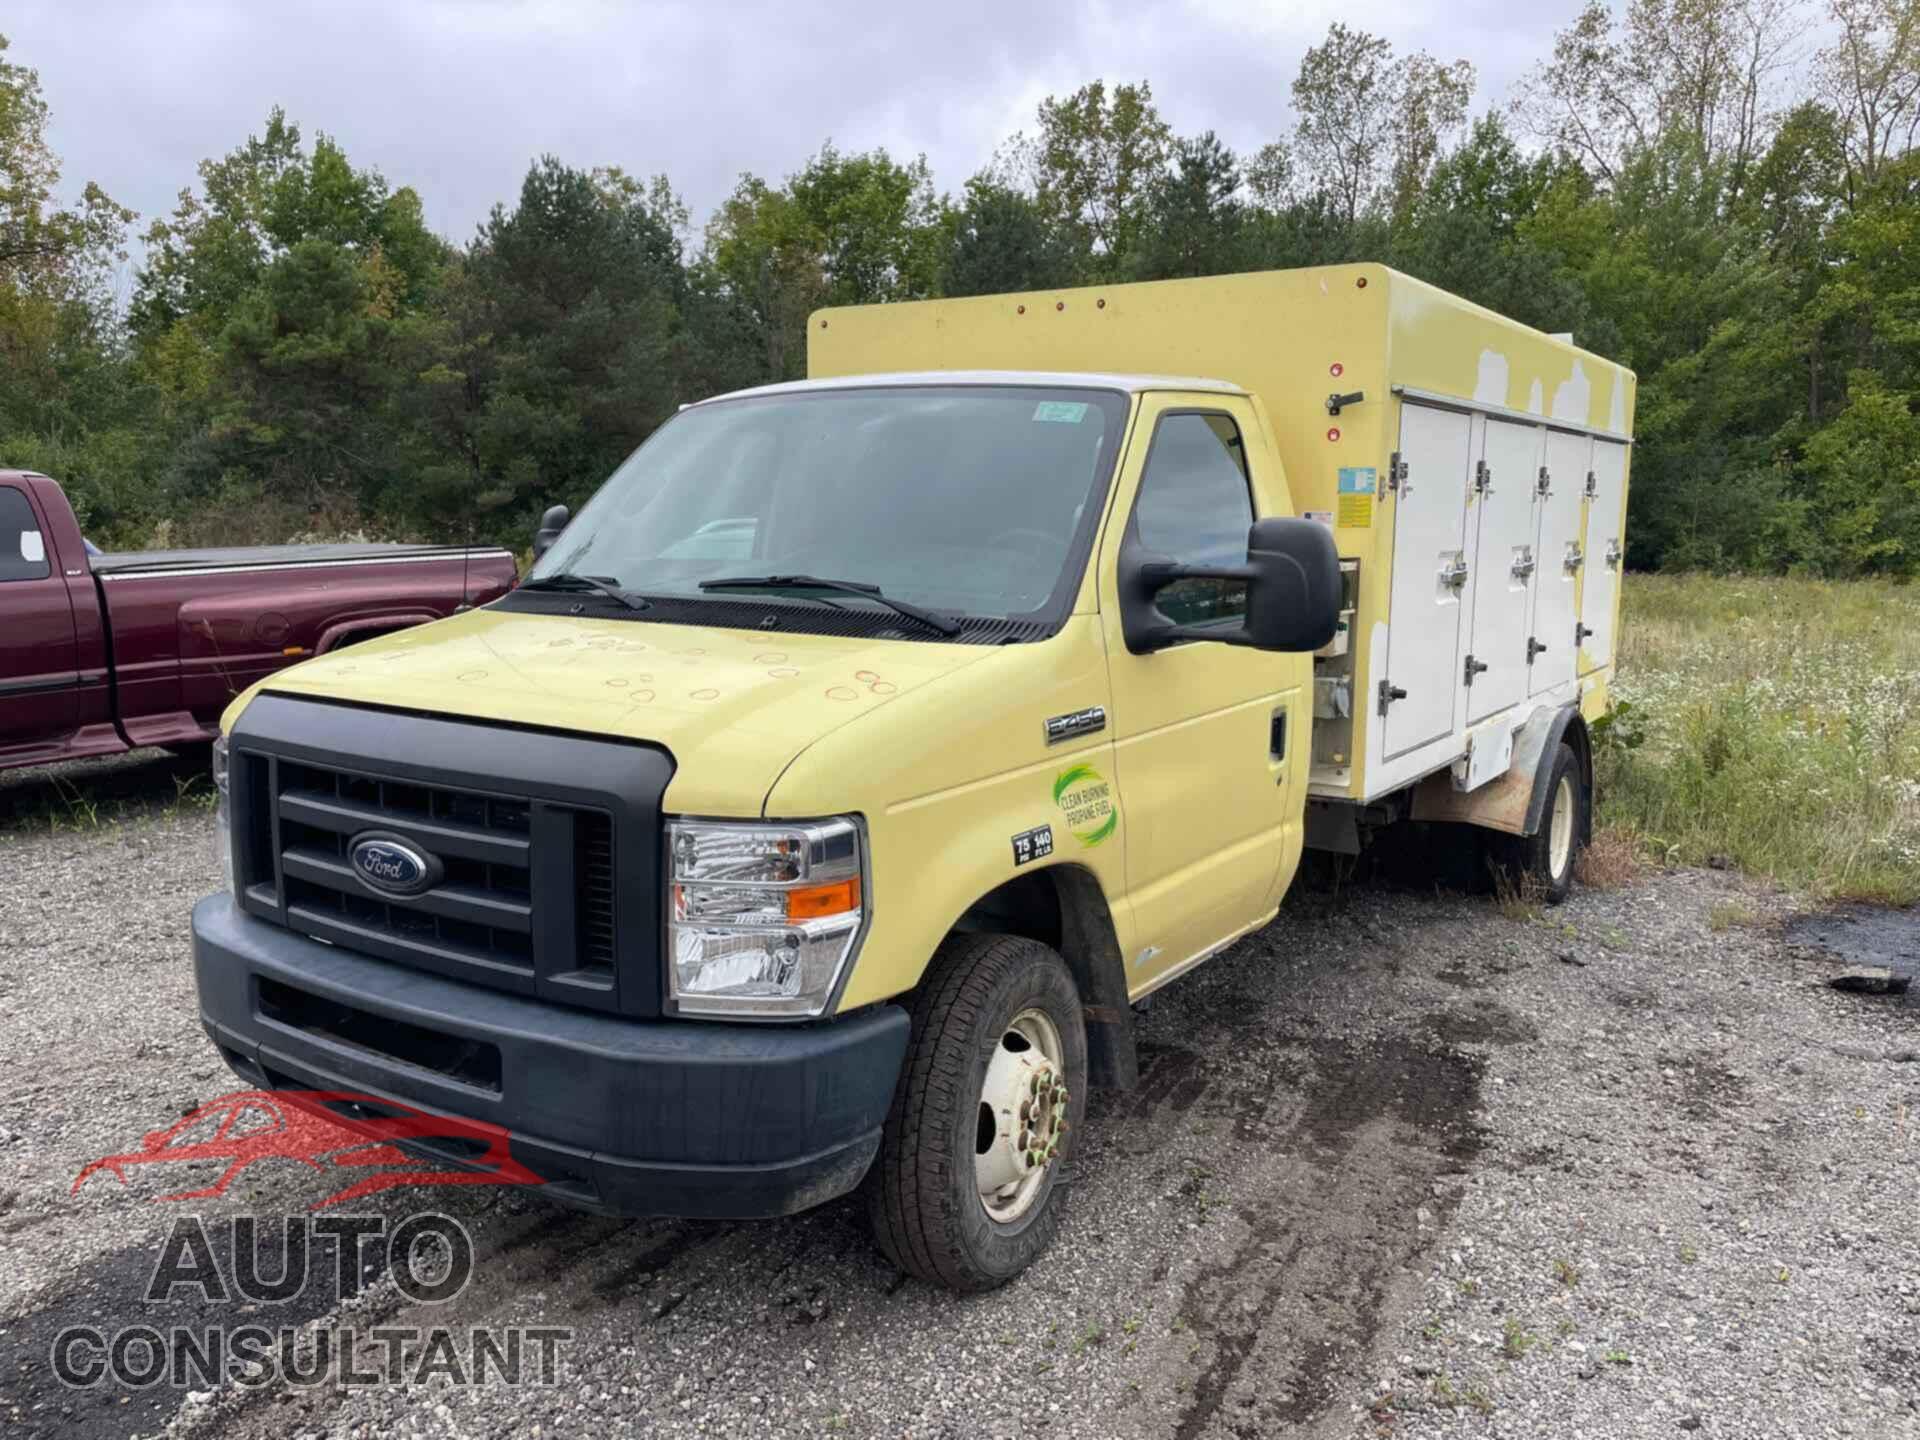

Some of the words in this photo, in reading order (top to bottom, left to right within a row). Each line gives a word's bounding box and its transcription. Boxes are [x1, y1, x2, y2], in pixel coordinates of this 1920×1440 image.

[1060, 790, 1082, 810] CLEAN
[1082, 782, 1110, 802] BURNING
[1066, 805, 1096, 828] PROPANE
[1095, 799, 1112, 817] FUEL
[363, 847, 403, 879] Ford
